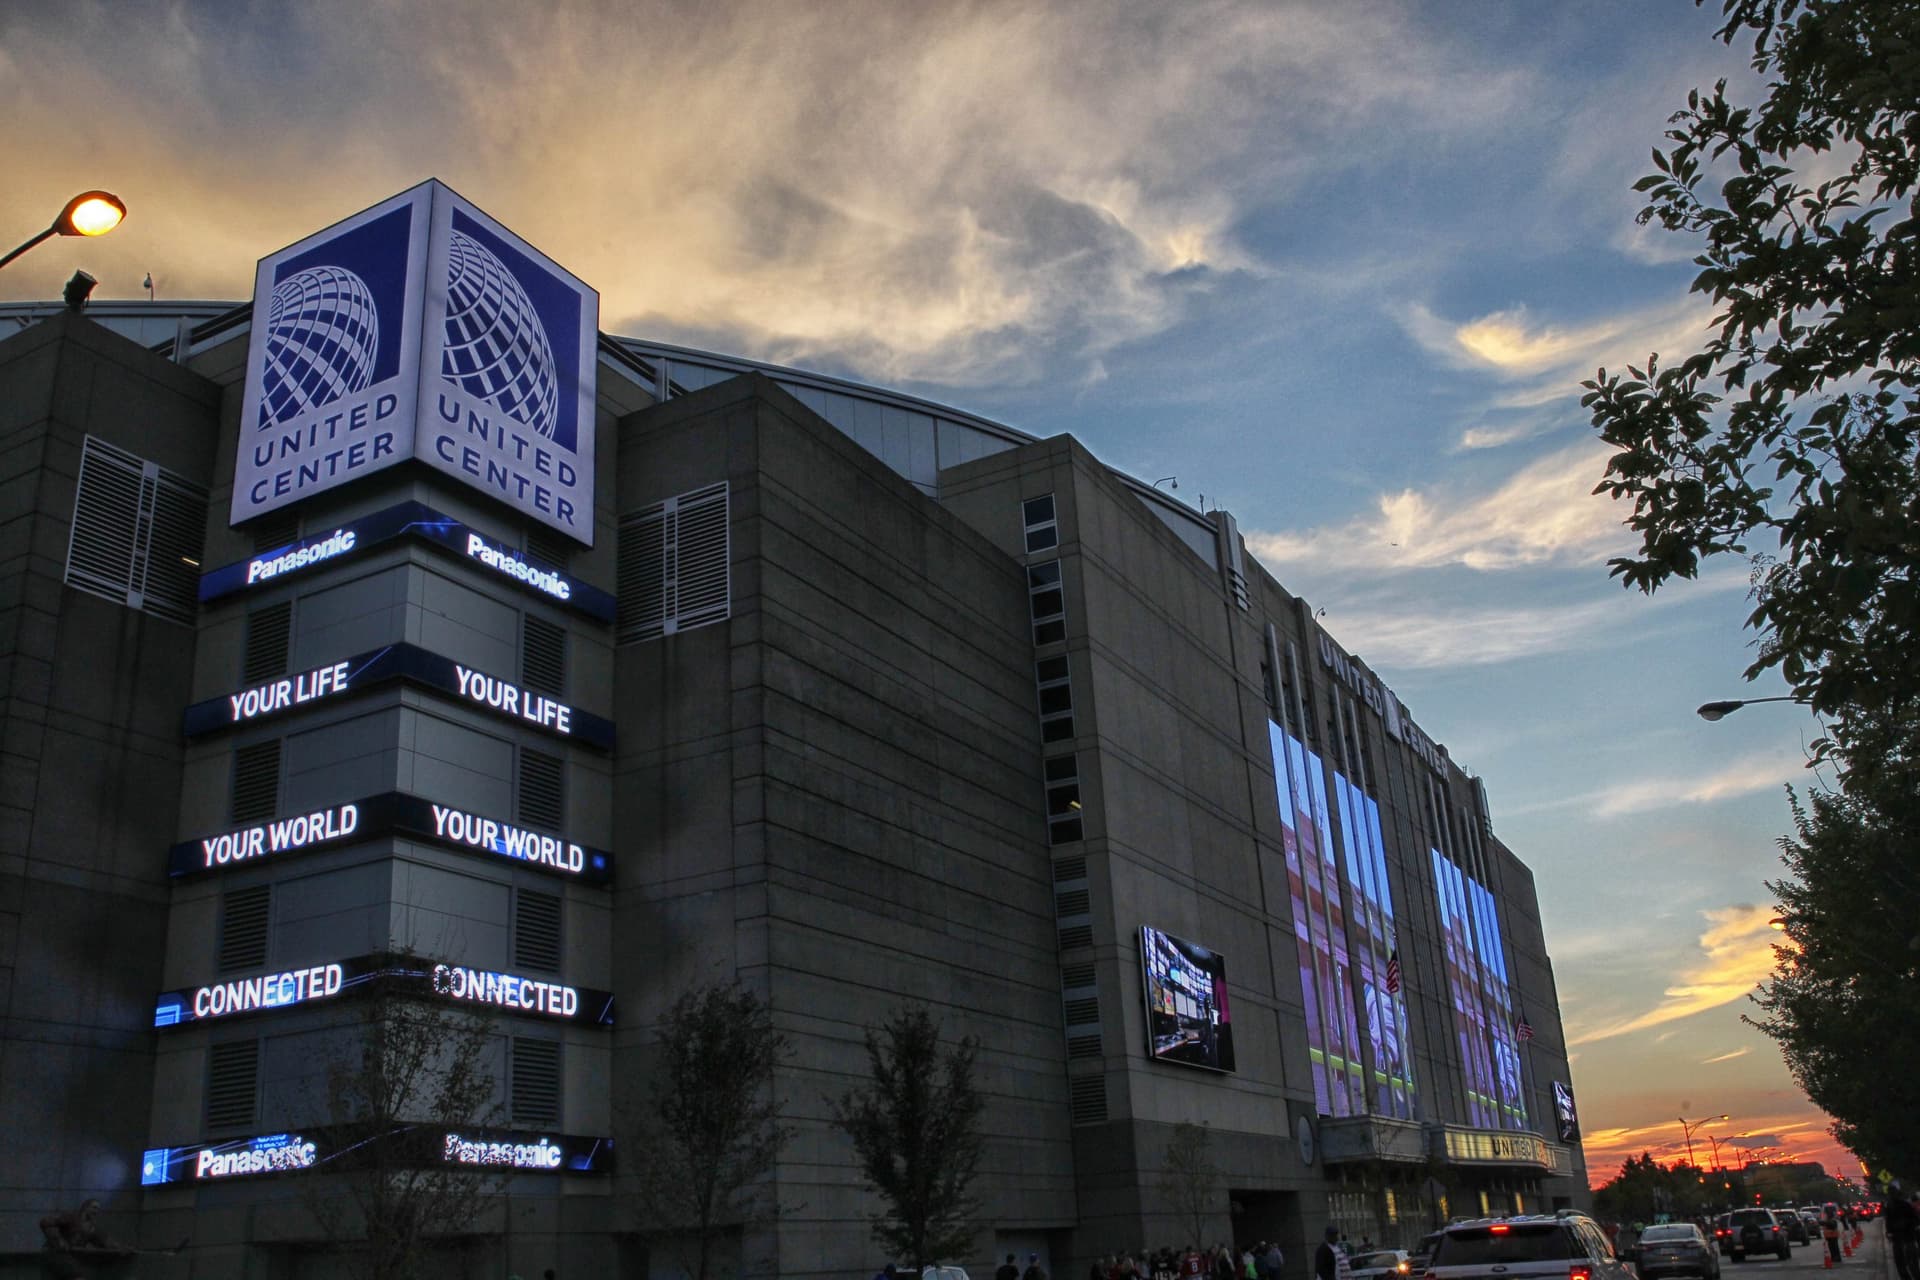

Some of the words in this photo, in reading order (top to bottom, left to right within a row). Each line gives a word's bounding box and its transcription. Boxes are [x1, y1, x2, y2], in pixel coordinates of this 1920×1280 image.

[255, 393, 398, 468] UNITED
[438, 394, 577, 488] UNITED
[250, 432, 394, 504] CENTER
[436, 435, 575, 526] CENTER
[247, 529, 355, 584] Panasonic
[467, 533, 570, 600] Panasonic
[231, 680, 291, 721] YOUR
[296, 662, 349, 703] LIFE
[455, 665, 518, 715] YOUR
[523, 692, 570, 734] LIFE
[1319, 633, 1383, 717] UNITED
[1401, 718, 1450, 783] CENTER
[202, 828, 264, 868] YOUR
[269, 805, 357, 851] WORLD
[432, 805, 498, 850] YOUR
[503, 825, 584, 873] WORLD
[194, 964, 342, 1017] CONNECTED
[433, 964, 577, 1016] CONNECTED
[196, 1136, 316, 1178] Panasonic
[445, 1134, 561, 1167] Panasonic
